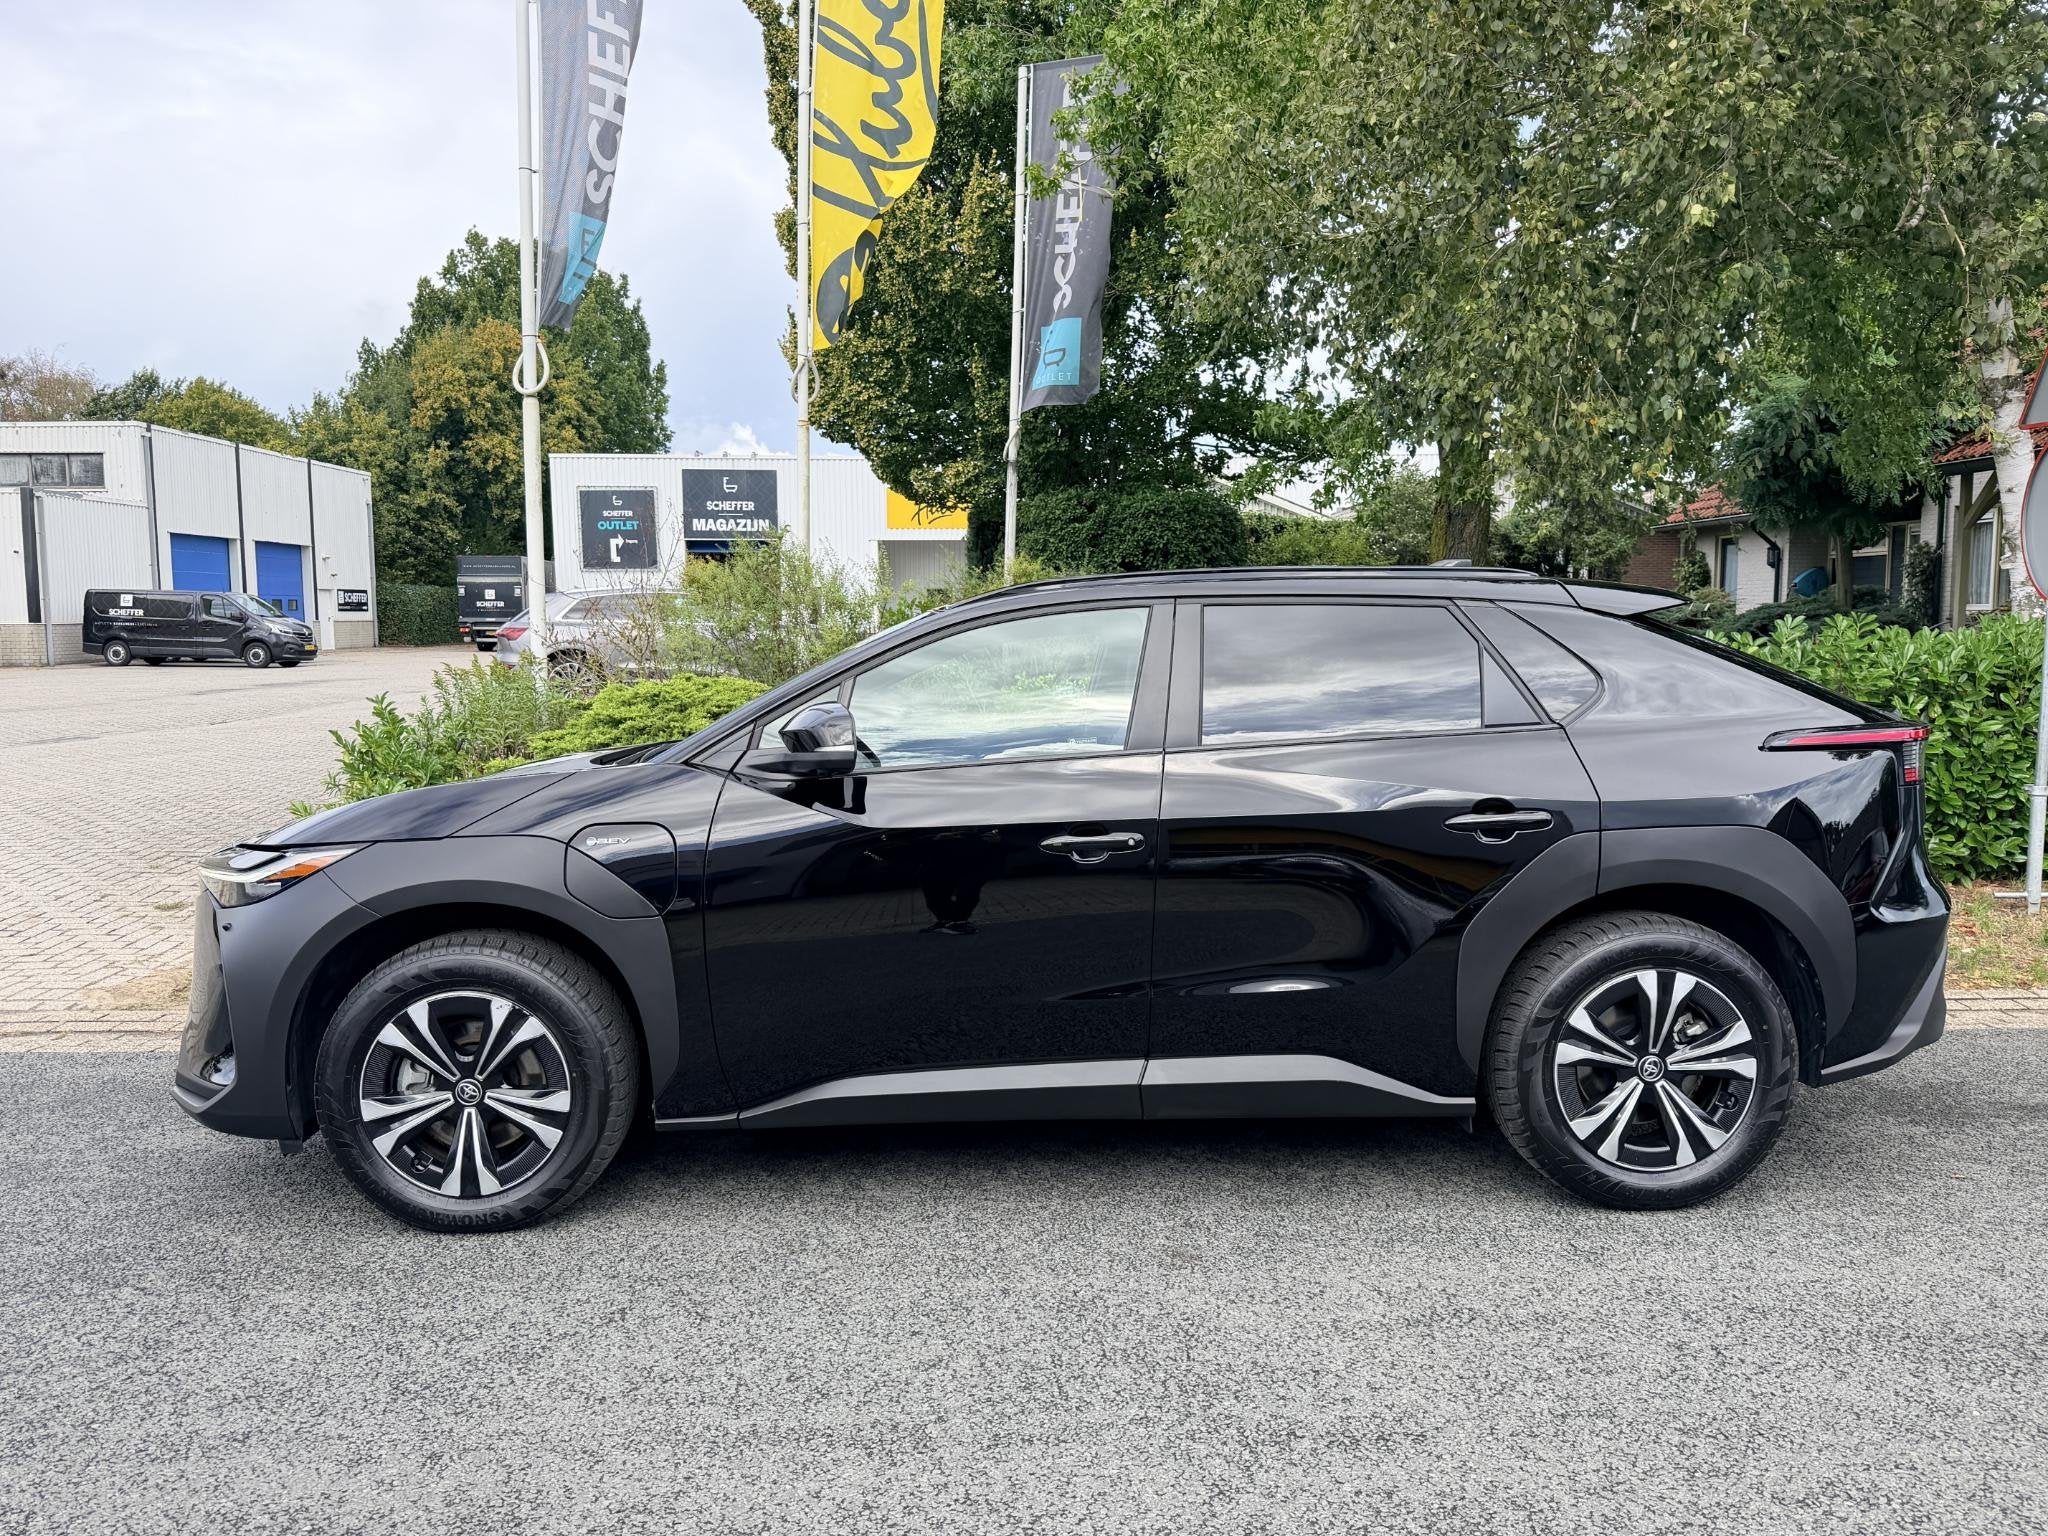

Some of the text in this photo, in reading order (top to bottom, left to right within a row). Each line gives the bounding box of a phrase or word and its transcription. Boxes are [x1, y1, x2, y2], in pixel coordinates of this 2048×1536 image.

[585, 0, 631, 204] SCHEF
[706, 501, 755, 511] SCHEFFER
[597, 521, 639, 530] OUTLET
[692, 518, 770, 532] MAGAZIJN
[344, 592, 368, 603] SCHEFFER
[108, 608, 144, 616] SCHEFFER
